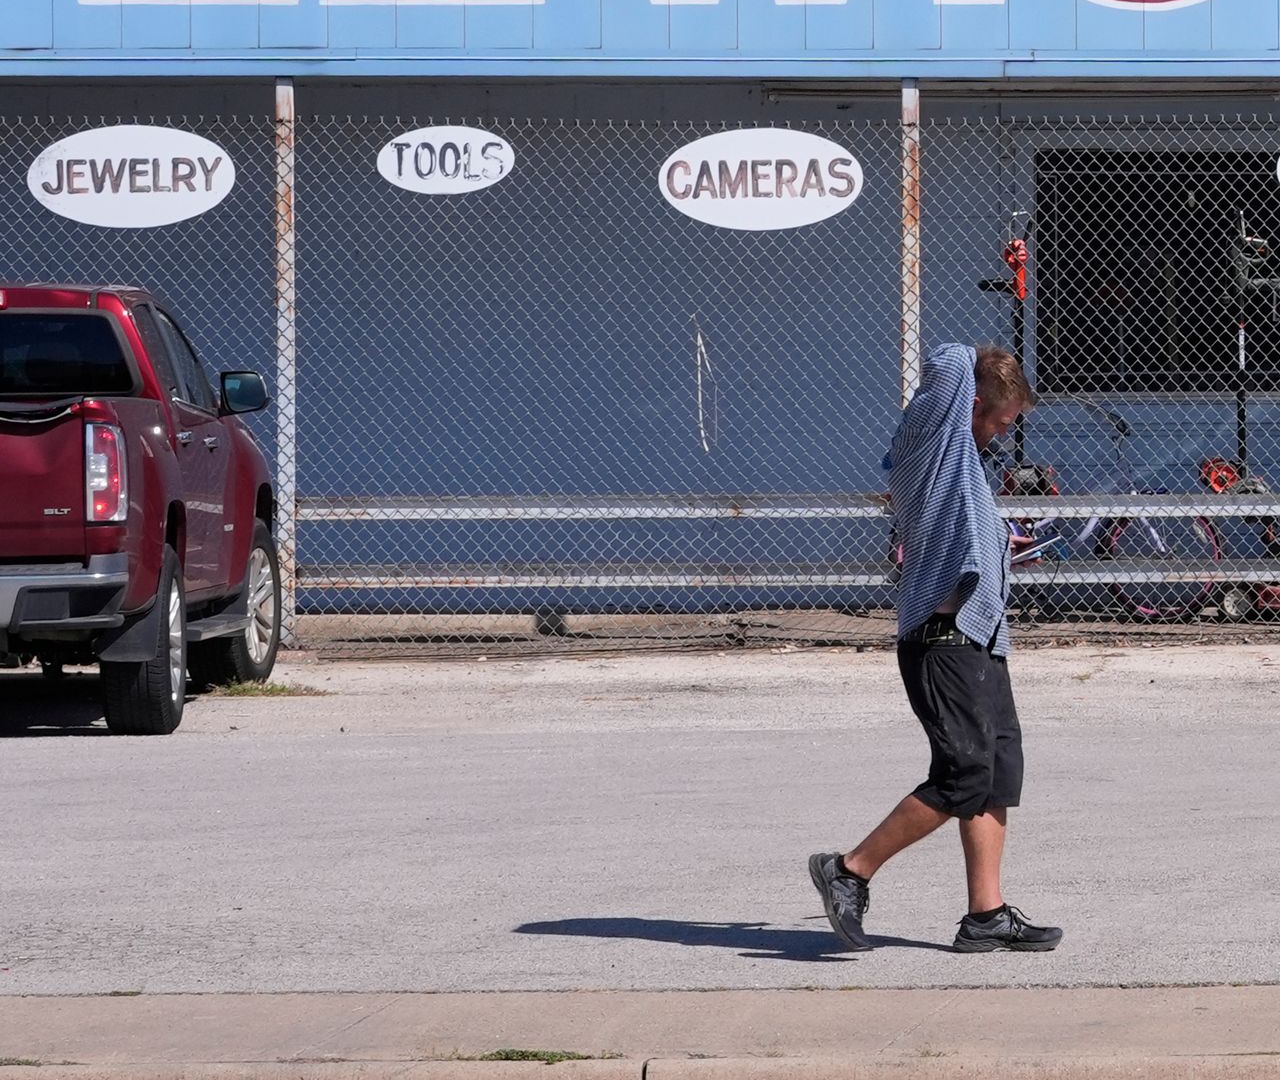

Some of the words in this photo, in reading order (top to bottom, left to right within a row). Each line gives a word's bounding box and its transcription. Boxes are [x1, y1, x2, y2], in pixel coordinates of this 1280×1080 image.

[41, 156, 222, 196] JEWELRY
[391, 141, 504, 181] TOOLS
[666, 157, 856, 200] CAMERAS
